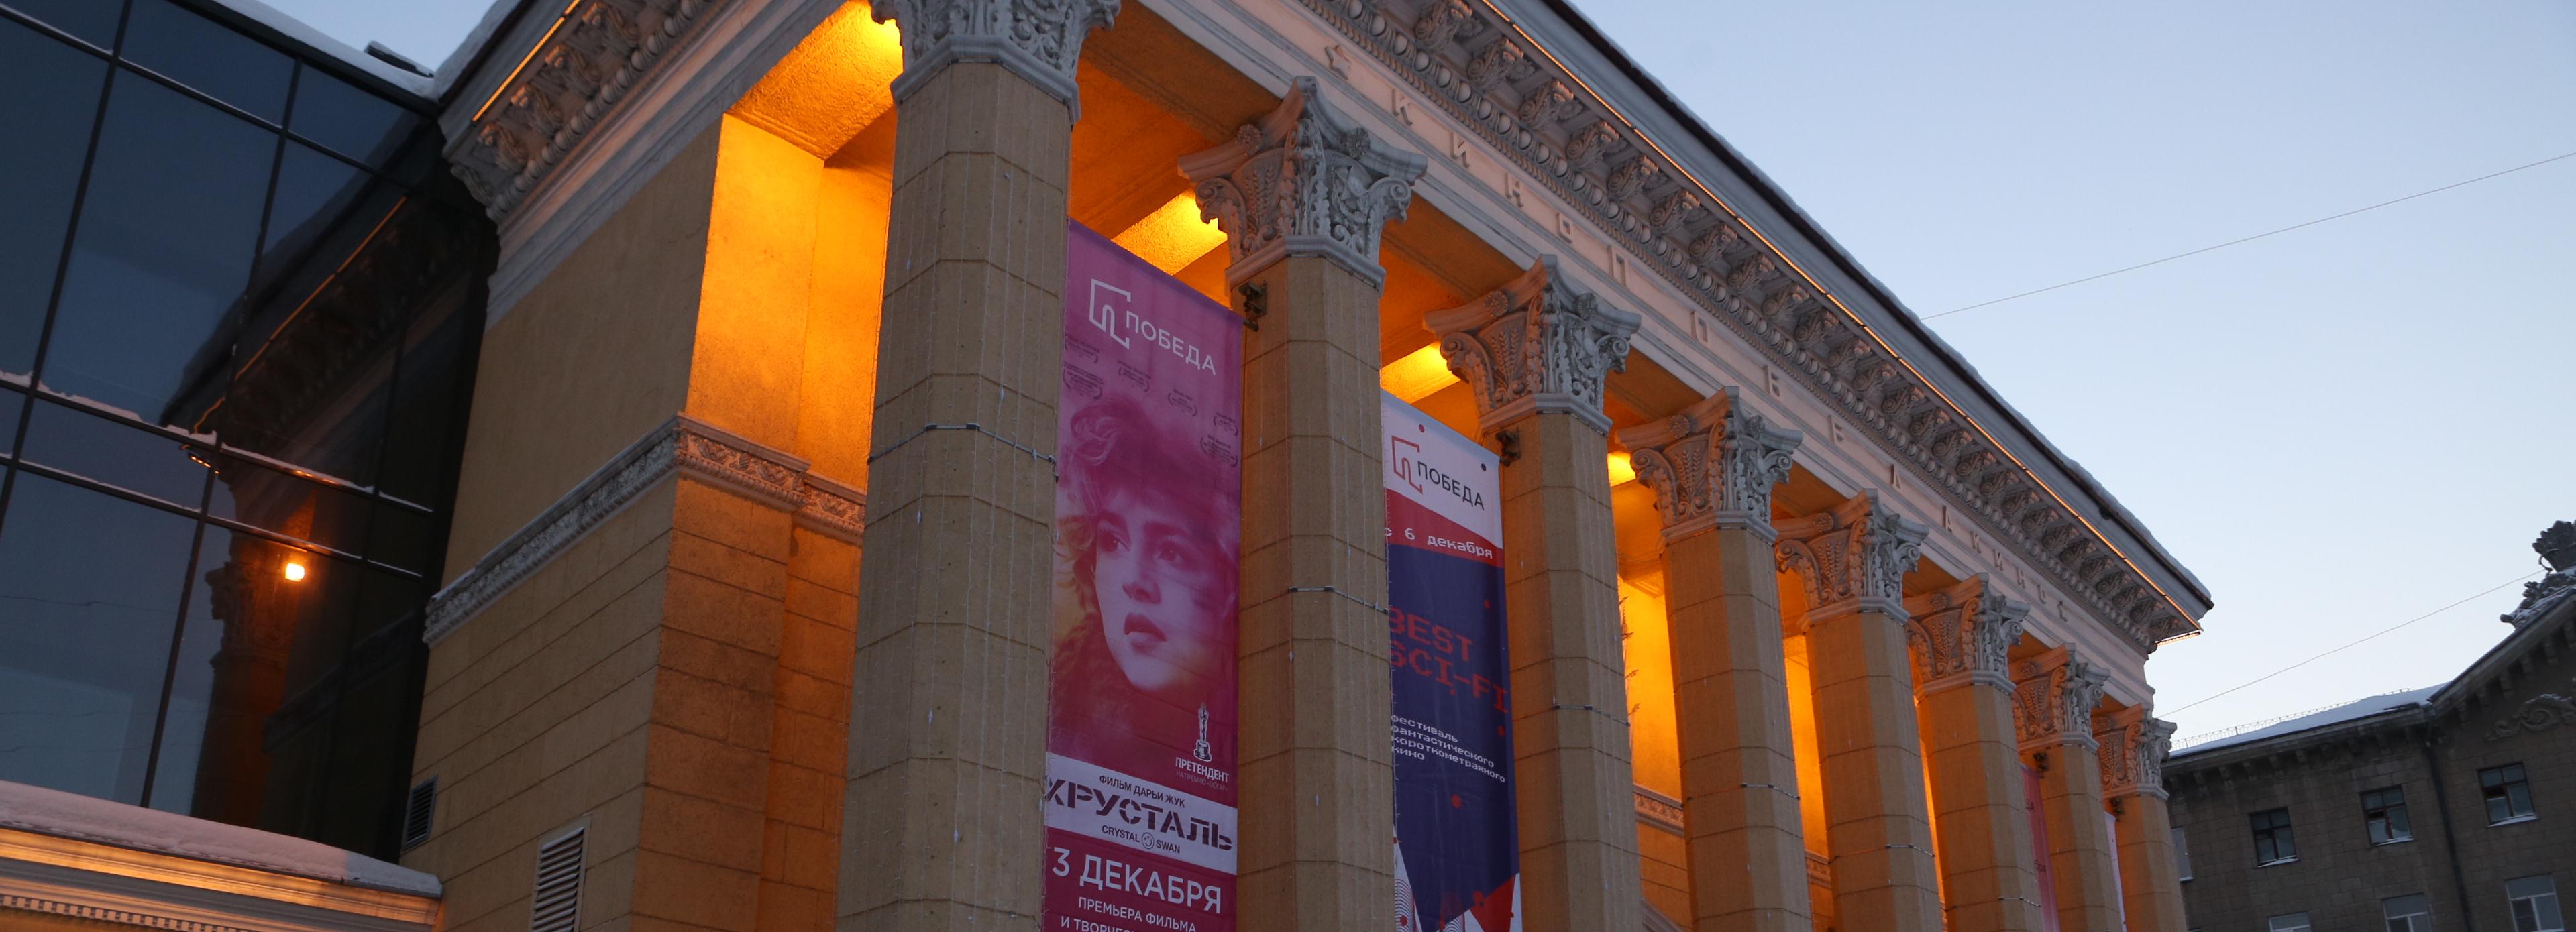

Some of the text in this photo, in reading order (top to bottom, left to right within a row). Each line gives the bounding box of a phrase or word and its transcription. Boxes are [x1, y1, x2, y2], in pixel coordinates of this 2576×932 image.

[1126, 310, 1216, 376] ПОБЕДА
[1417, 461, 1485, 510] ПОБЕДА
[1405, 528, 1416, 540] 6
[1427, 536, 1493, 559] декабря
[1389, 606, 1474, 662] BEST
[1390, 640, 1508, 714] SCI-FI
[1391, 715, 1458, 742] фестиваль
[1391, 725, 1495, 768] фантастического
[1175, 756, 1230, 783] ПРЕТЕНДЕНТ
[1391, 746, 1425, 760] кино
[1391, 736, 1505, 783] короткометражного
[1099, 775, 1185, 808] ФИЛЬМ ДАРЬИ ЖУК
[1045, 778, 1232, 851] ХРУСТАЛЬ
[1102, 825, 1181, 854] CRYSTAL SWAN
[1053, 847, 1222, 914] 3 ДЕКАБРЯ
[1061, 916, 1069, 928] И
[1079, 897, 1196, 932] ПРЕМЬЕРА ФИЛЬМА
